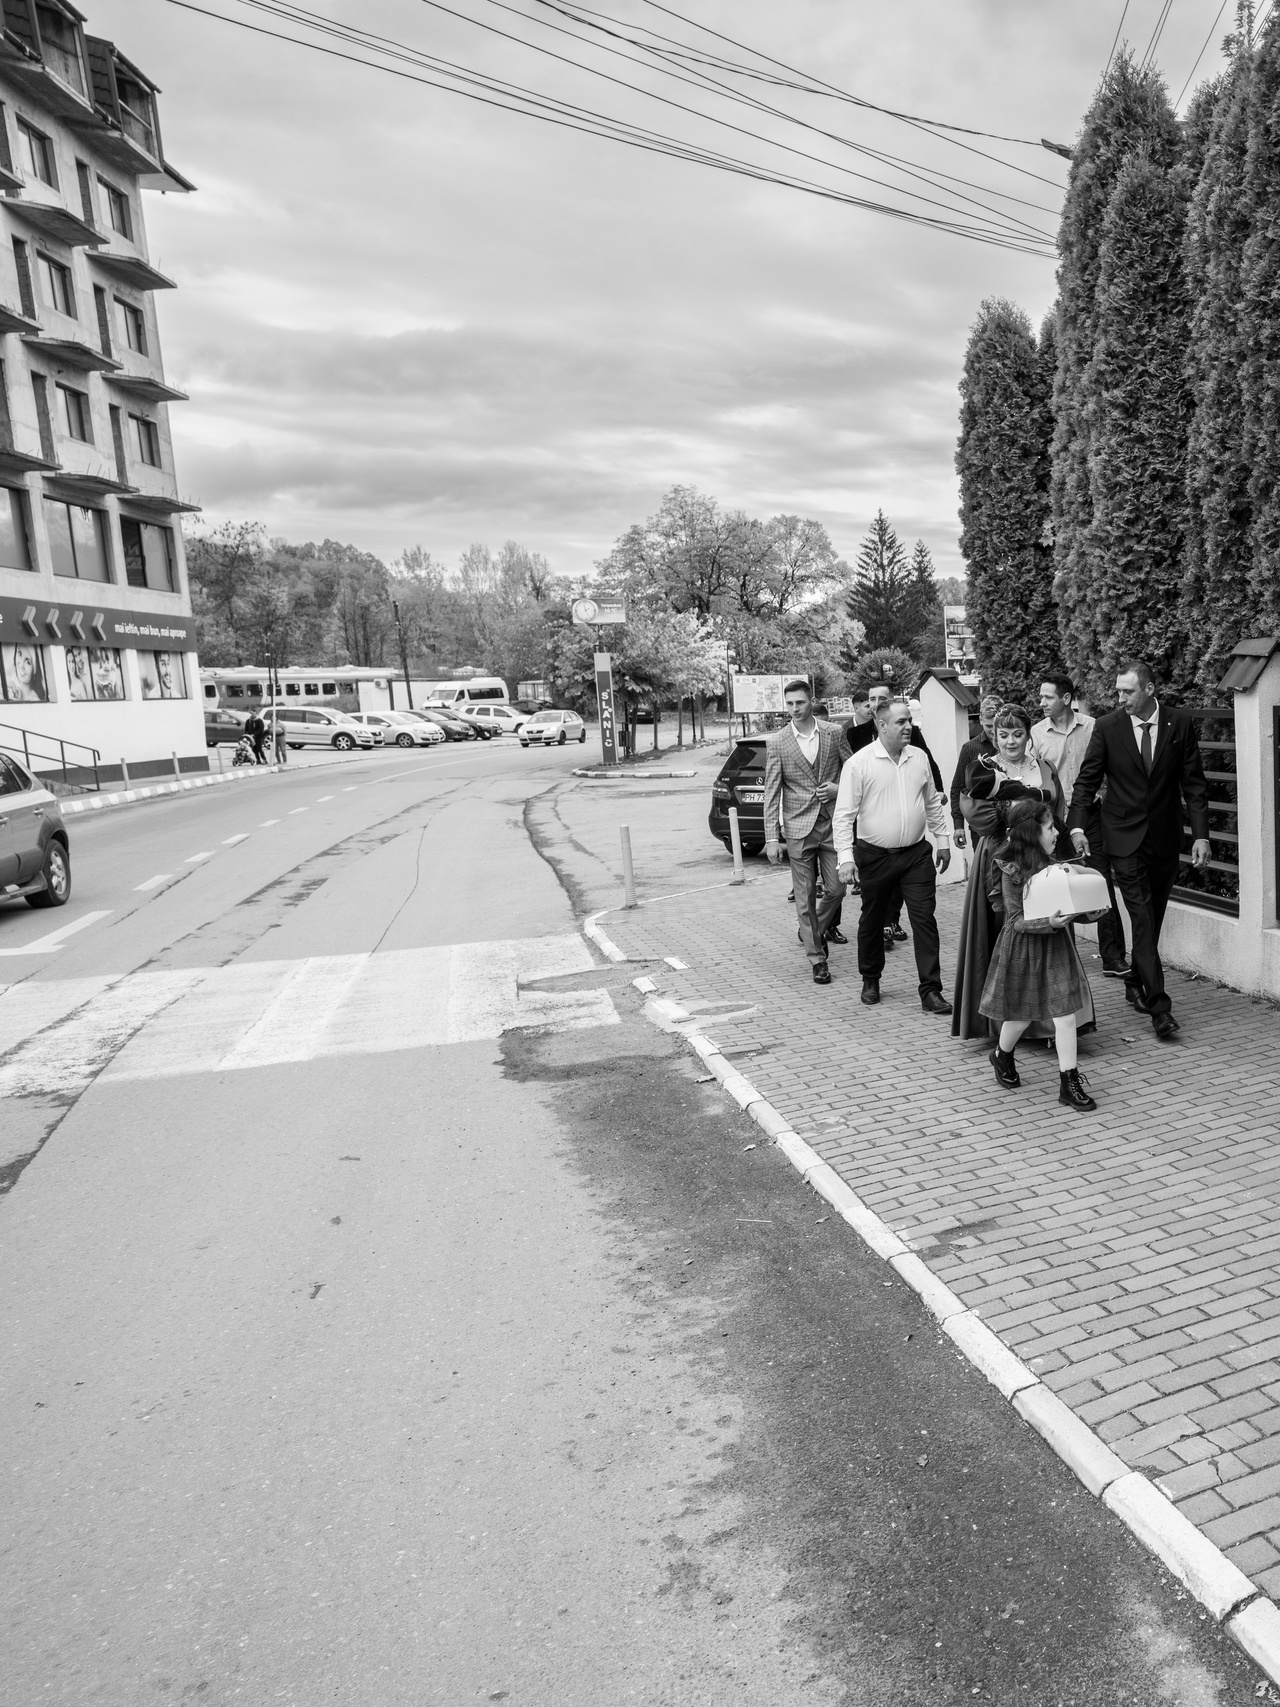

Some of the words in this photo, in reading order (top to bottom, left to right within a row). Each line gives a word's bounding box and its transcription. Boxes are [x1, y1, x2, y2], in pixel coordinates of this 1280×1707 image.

[115, 623, 124, 633] mai
[140, 625, 149, 635] mai
[161, 627, 169, 637] mai
[170, 629, 187, 640] aproape
[745, 793, 755, 802] PH
